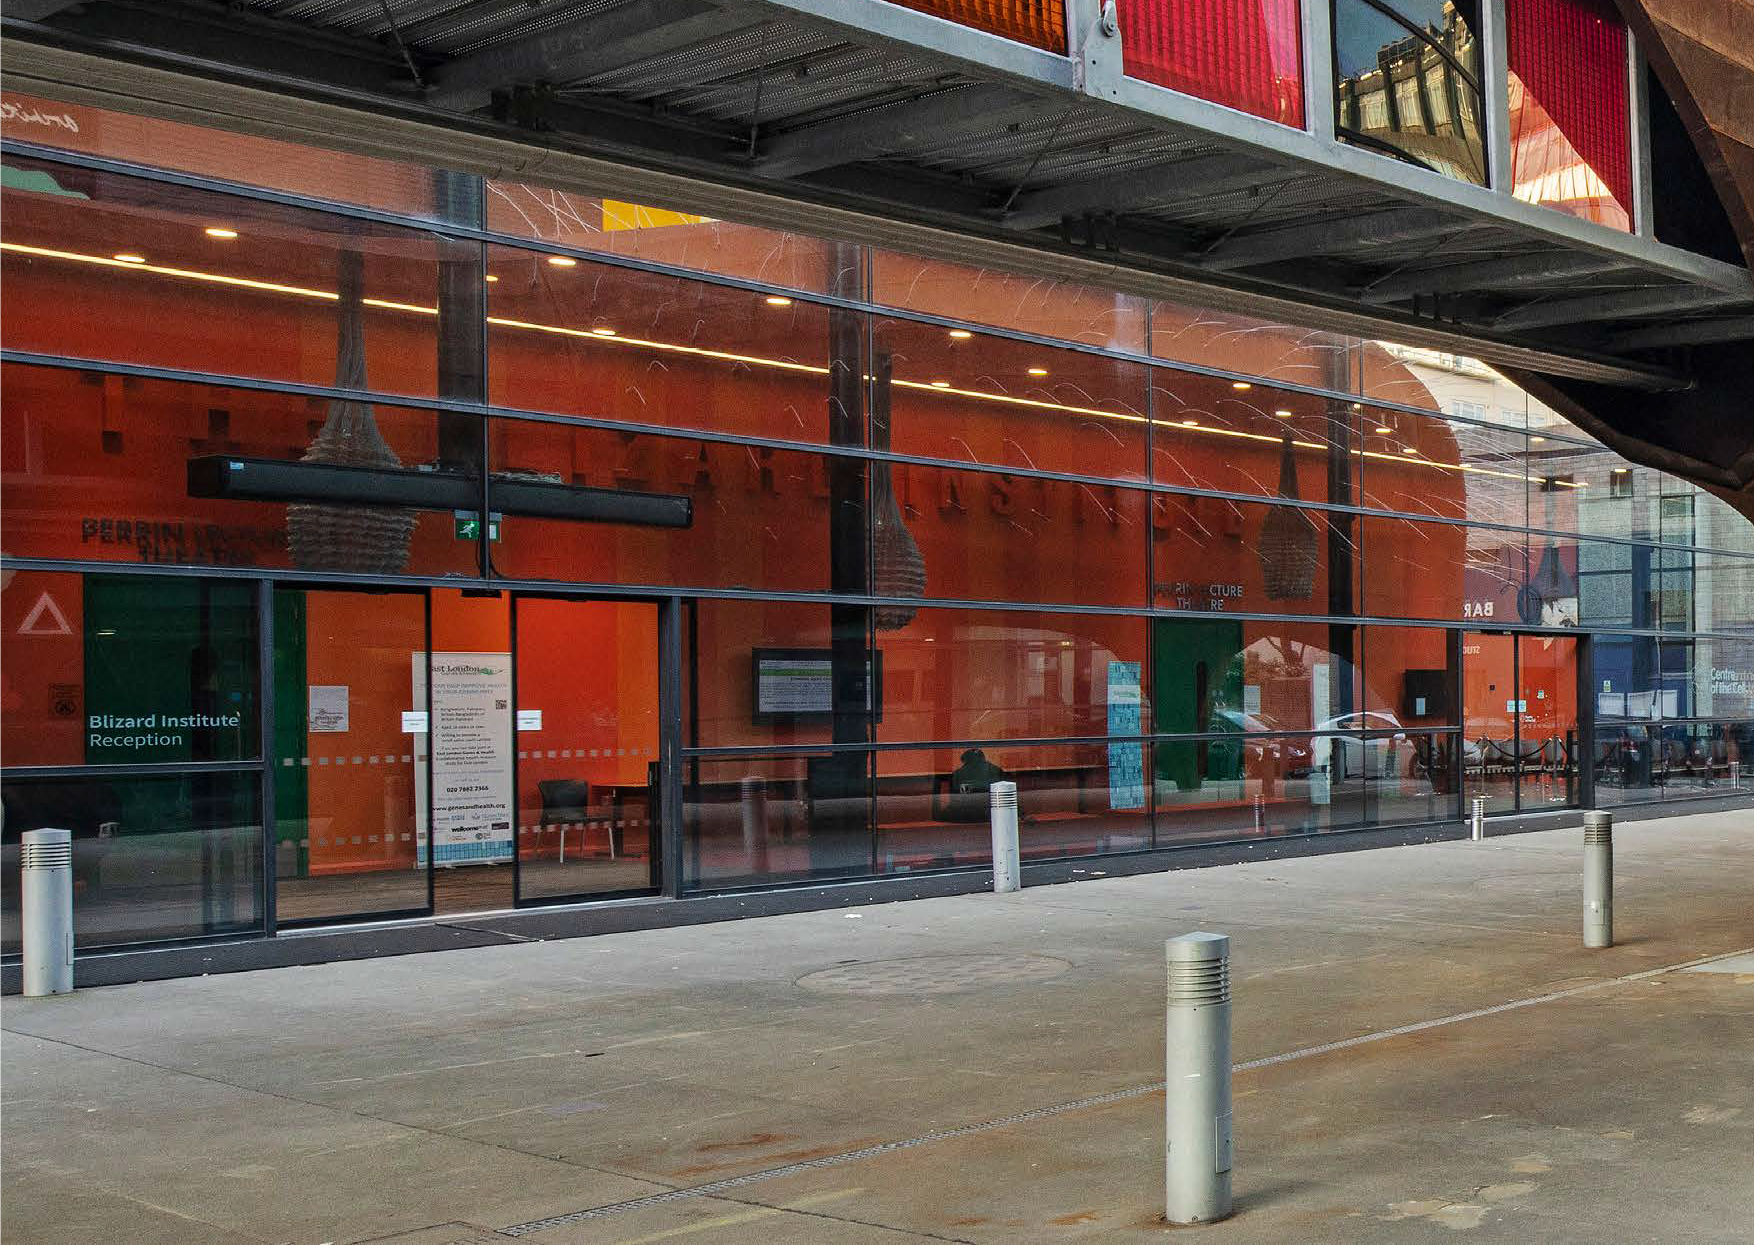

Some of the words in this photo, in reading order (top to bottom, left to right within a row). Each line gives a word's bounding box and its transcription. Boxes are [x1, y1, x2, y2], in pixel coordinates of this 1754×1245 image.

[89, 713, 156, 729] Blizard
[161, 712, 239, 729] Institute
[90, 732, 183, 750] Reception
